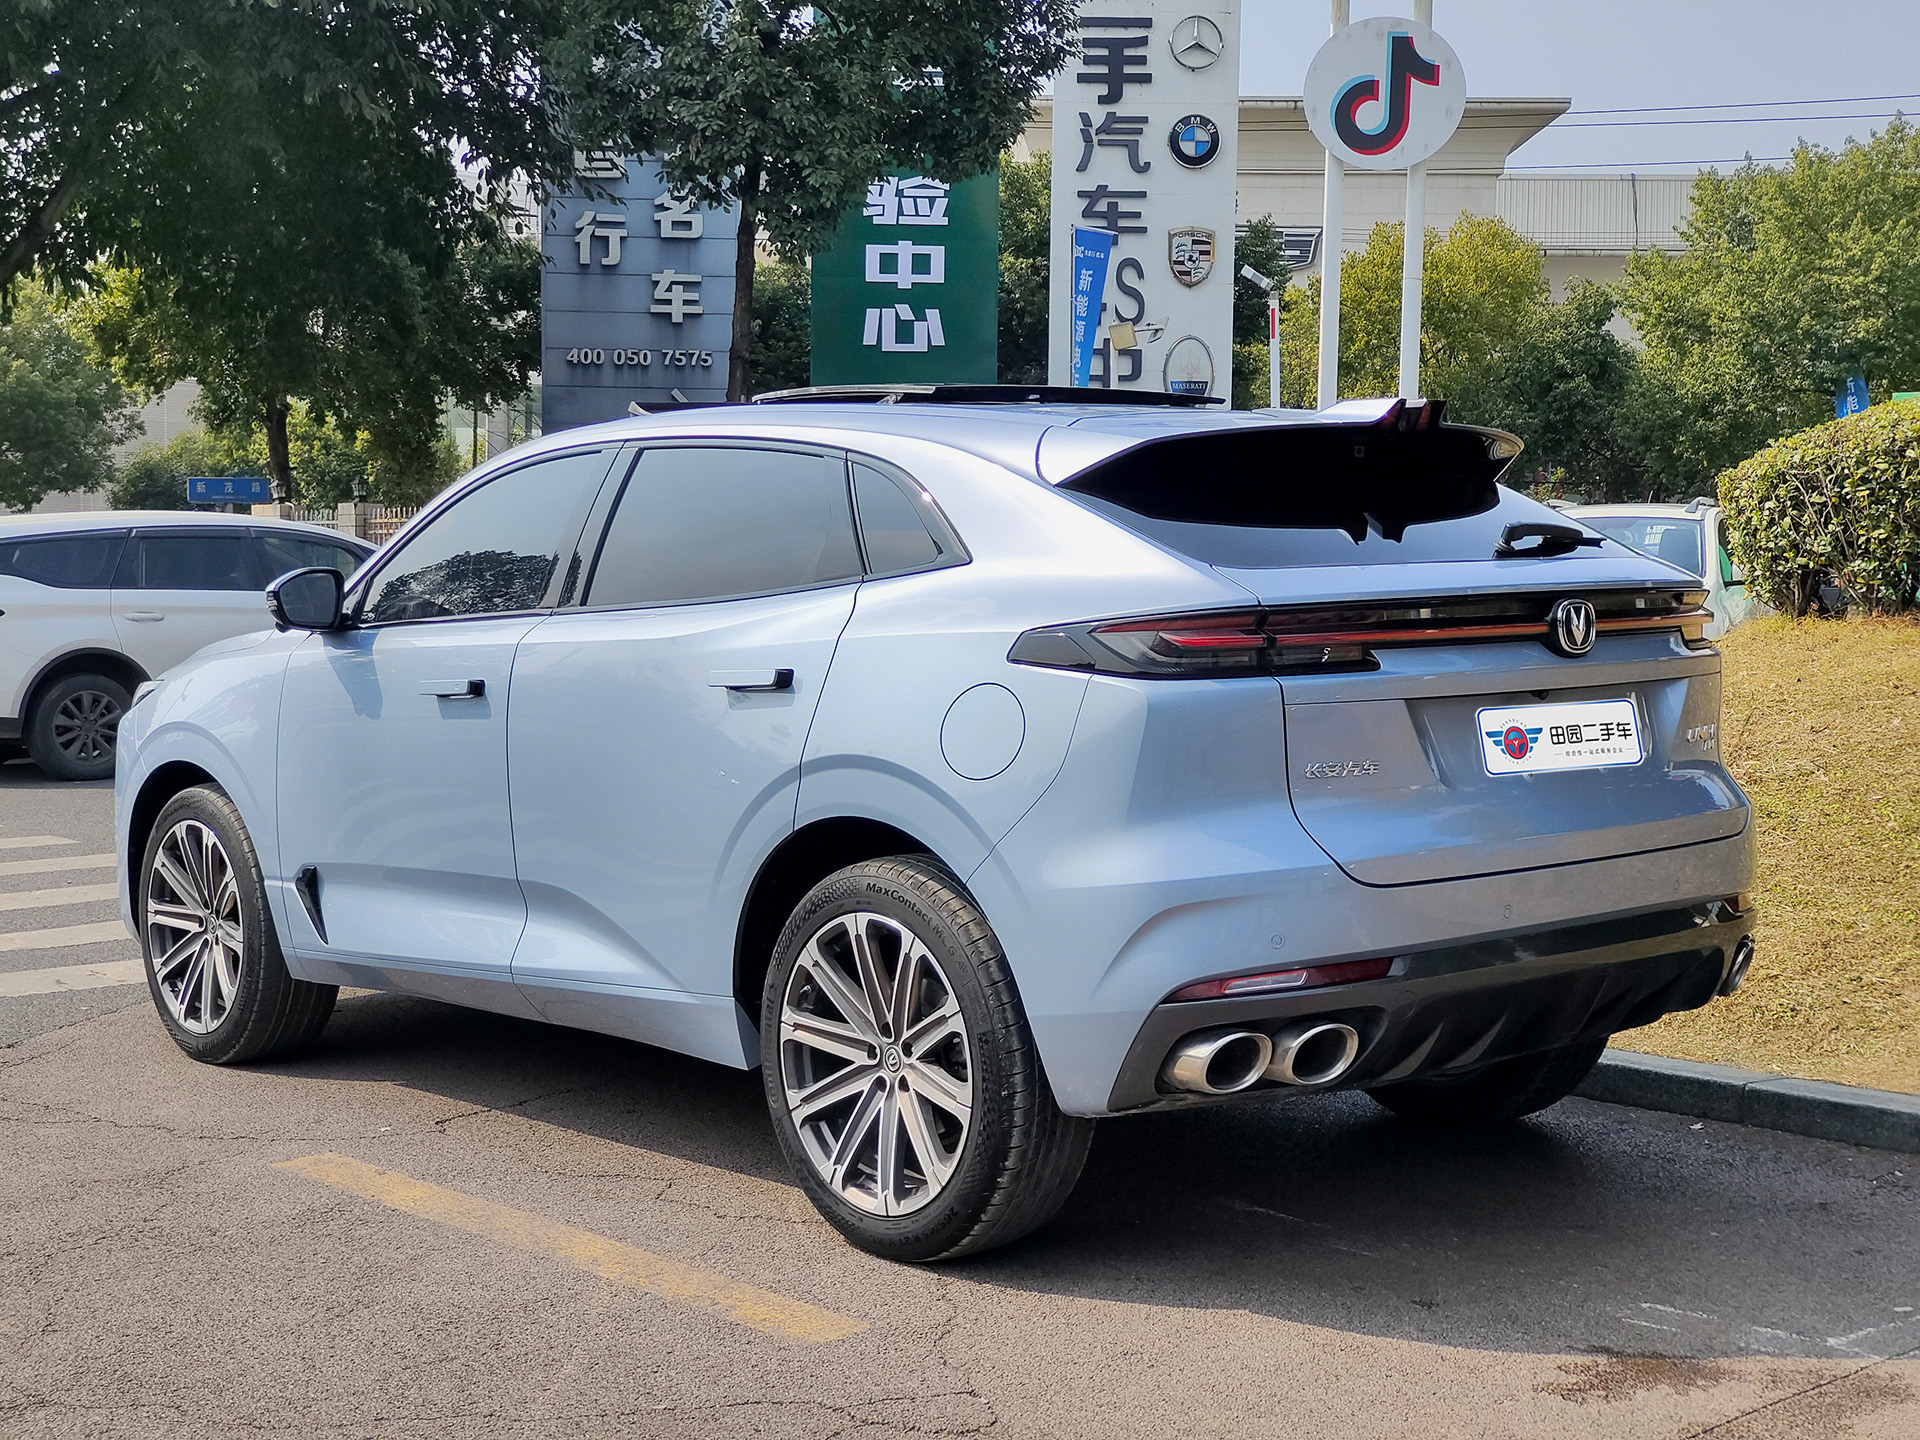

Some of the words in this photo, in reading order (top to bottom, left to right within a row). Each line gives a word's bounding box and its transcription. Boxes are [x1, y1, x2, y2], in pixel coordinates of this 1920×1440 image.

[1175, 116, 1216, 134] BMW
[1172, 231, 1212, 240] PORSCHE
[650, 186, 704, 324] 名车
[863, 175, 950, 352] 验中心
[566, 347, 605, 366] 400
[613, 348, 652, 367] 050
[661, 349, 714, 368] 7575
[1172, 382, 1206, 390] MASERATI
[196, 481, 261, 493] 新茂路
[1549, 721, 1633, 745] 田园二手车
[1304, 758, 1380, 779] 长安汽车
[865, 882, 935, 927] MaxContact
